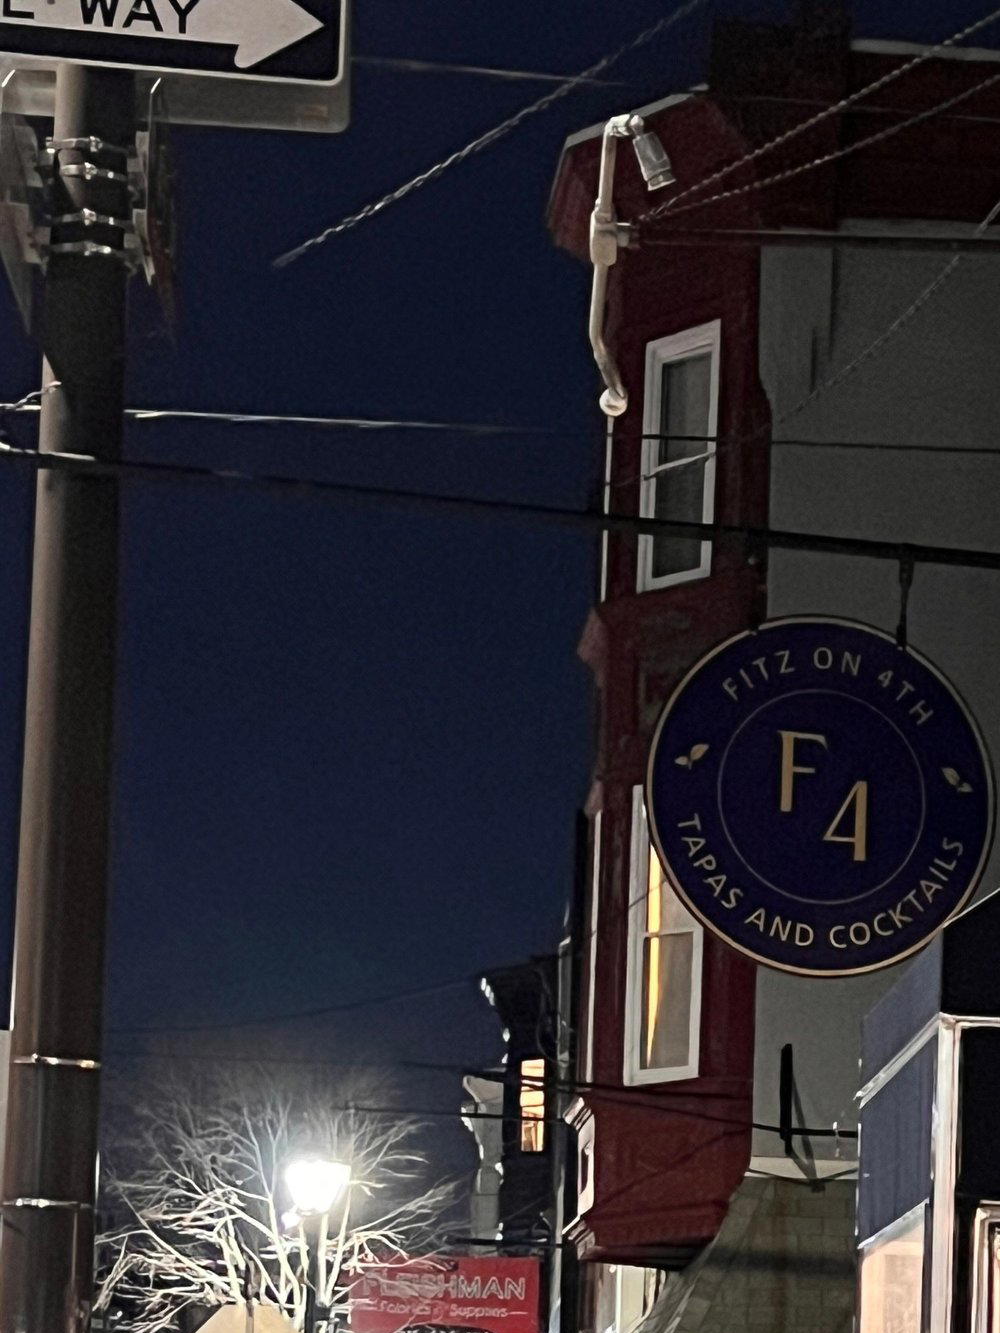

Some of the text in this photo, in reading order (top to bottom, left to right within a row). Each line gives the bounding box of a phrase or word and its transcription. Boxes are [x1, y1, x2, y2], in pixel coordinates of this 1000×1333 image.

[80, 0, 199, 34] WAY
[721, 647, 935, 726] FITZ ON 4TH
[677, 813, 964, 949] TAPAS AND COCKTAILS
